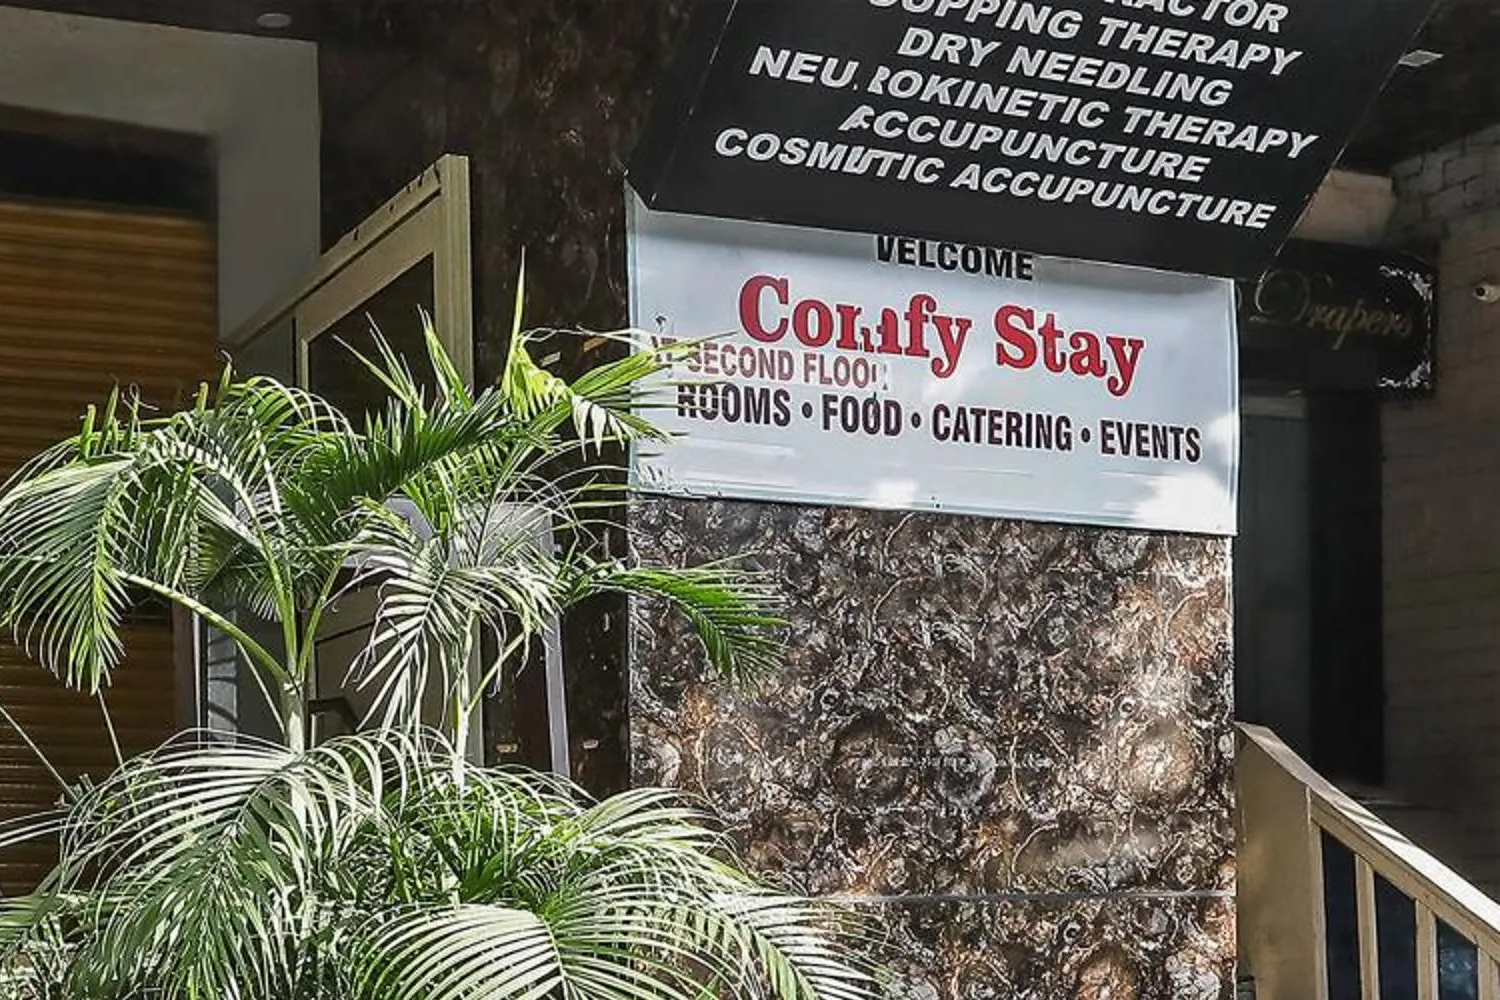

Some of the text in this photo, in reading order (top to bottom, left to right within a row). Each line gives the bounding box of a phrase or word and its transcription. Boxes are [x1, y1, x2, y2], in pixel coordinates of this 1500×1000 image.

[897, 26, 1234, 107] DRY NEEDLING
[1097, 15, 1302, 76] THERAPY
[837, 104, 1212, 183] ACCUPUNCTURE
[1122, 105, 1319, 159] THERAPY
[949, 162, 1278, 229] ACCUPUNCTURE
[993, 304, 1145, 397] Stay
[676, 383, 1202, 464] ROOMS FOOD CATERING EVENTS
